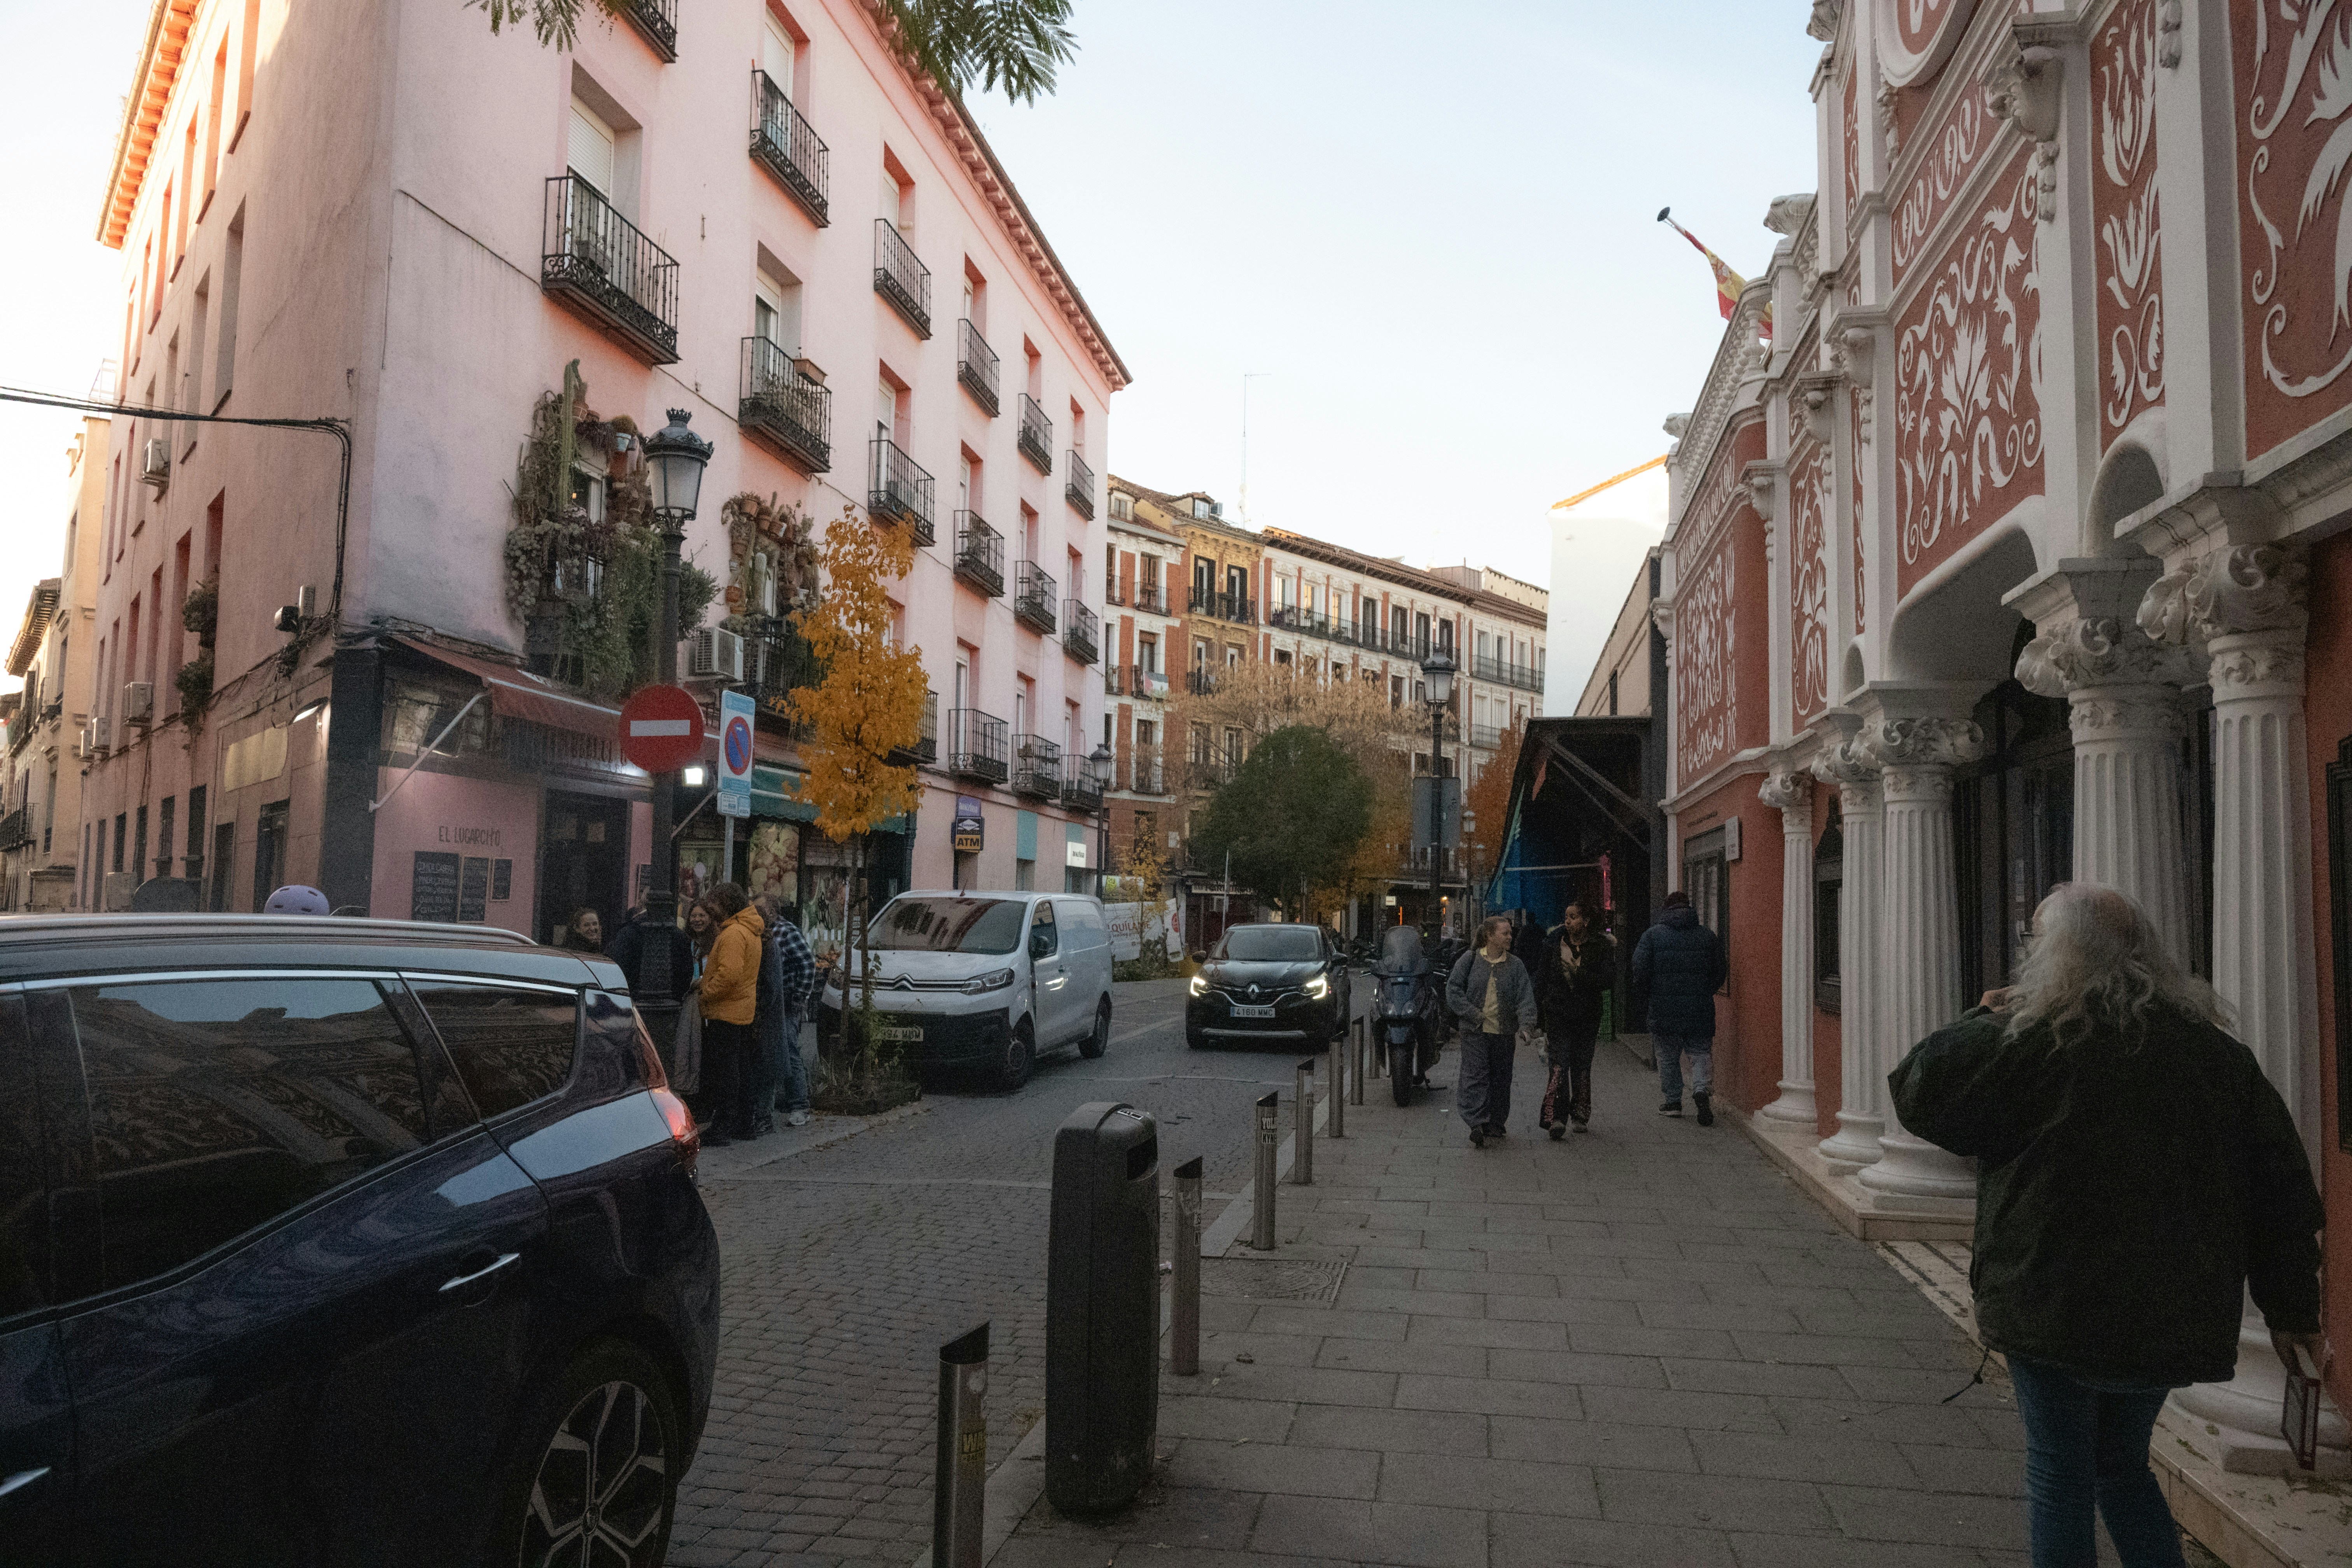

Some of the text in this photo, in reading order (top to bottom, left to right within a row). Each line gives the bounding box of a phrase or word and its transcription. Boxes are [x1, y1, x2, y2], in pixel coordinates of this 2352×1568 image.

[439, 826, 501, 847] EL LUGARCITO
[957, 838, 979, 847] ATM
